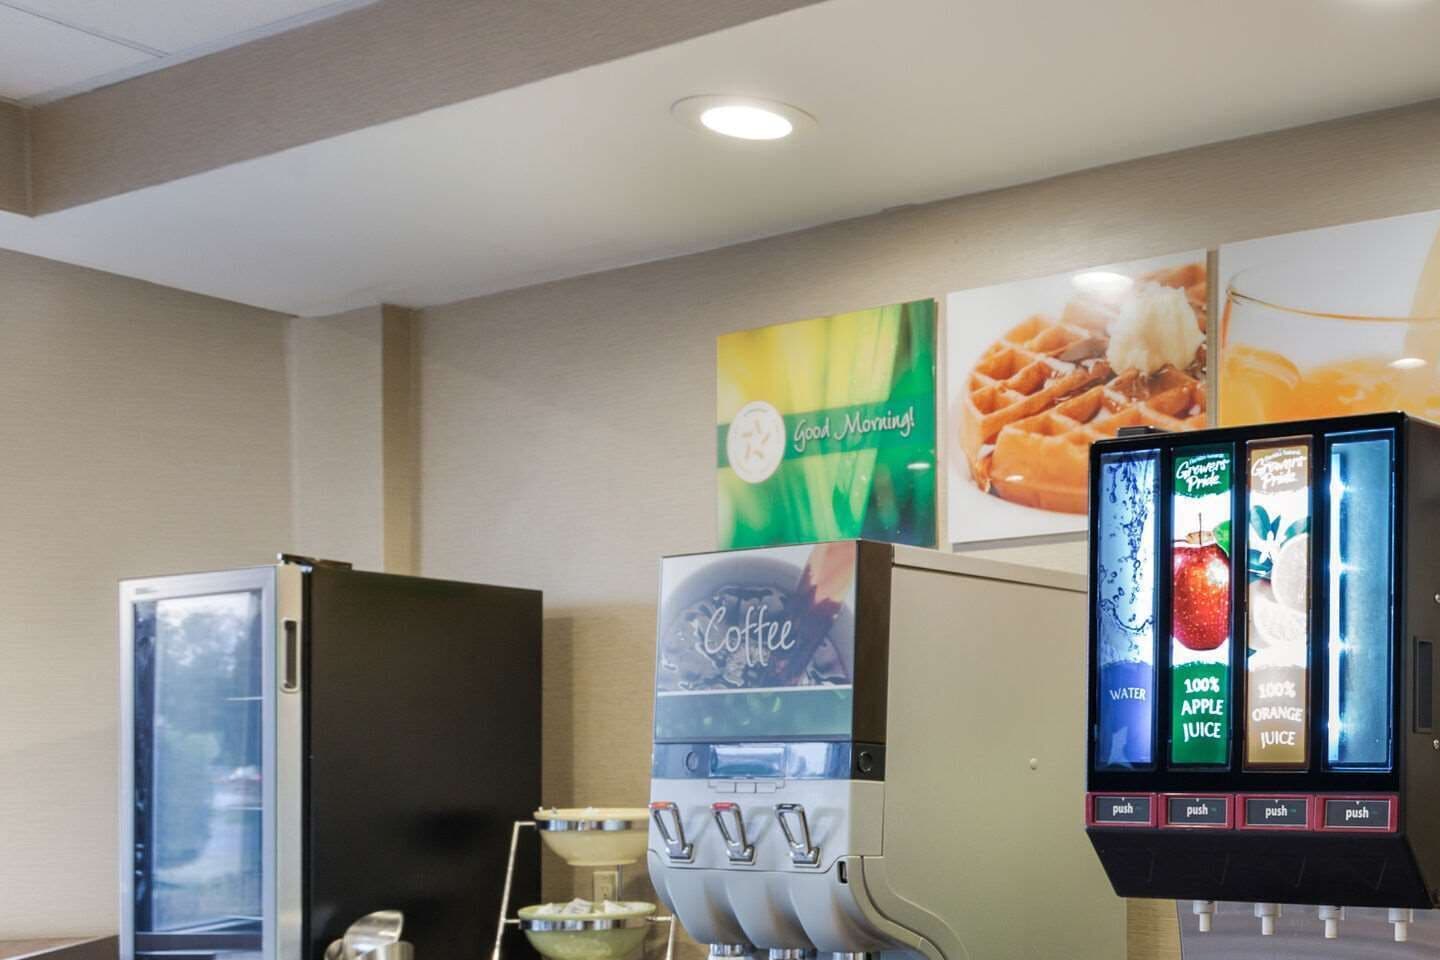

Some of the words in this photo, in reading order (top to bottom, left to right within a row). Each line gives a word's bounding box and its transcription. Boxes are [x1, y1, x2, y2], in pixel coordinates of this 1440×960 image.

[794, 417, 830, 453] Good
[834, 406, 915, 441] Morning!
[1186, 472, 1222, 493] Pride
[1260, 472, 1299, 490] Pride
[704, 605, 796, 667] Coffee
[1183, 676, 1220, 694] 100%
[1257, 680, 1296, 699] 100%
[1109, 687, 1146, 702] WATER
[1181, 699, 1224, 717] APPLE
[1252, 707, 1303, 724] ORANGE
[1182, 722, 1221, 743] JUICE
[1260, 731, 1296, 748] JUICE
[1112, 803, 1134, 817] push
[1186, 804, 1209, 818] push
[1265, 805, 1288, 819] push
[1345, 807, 1369, 821] push
